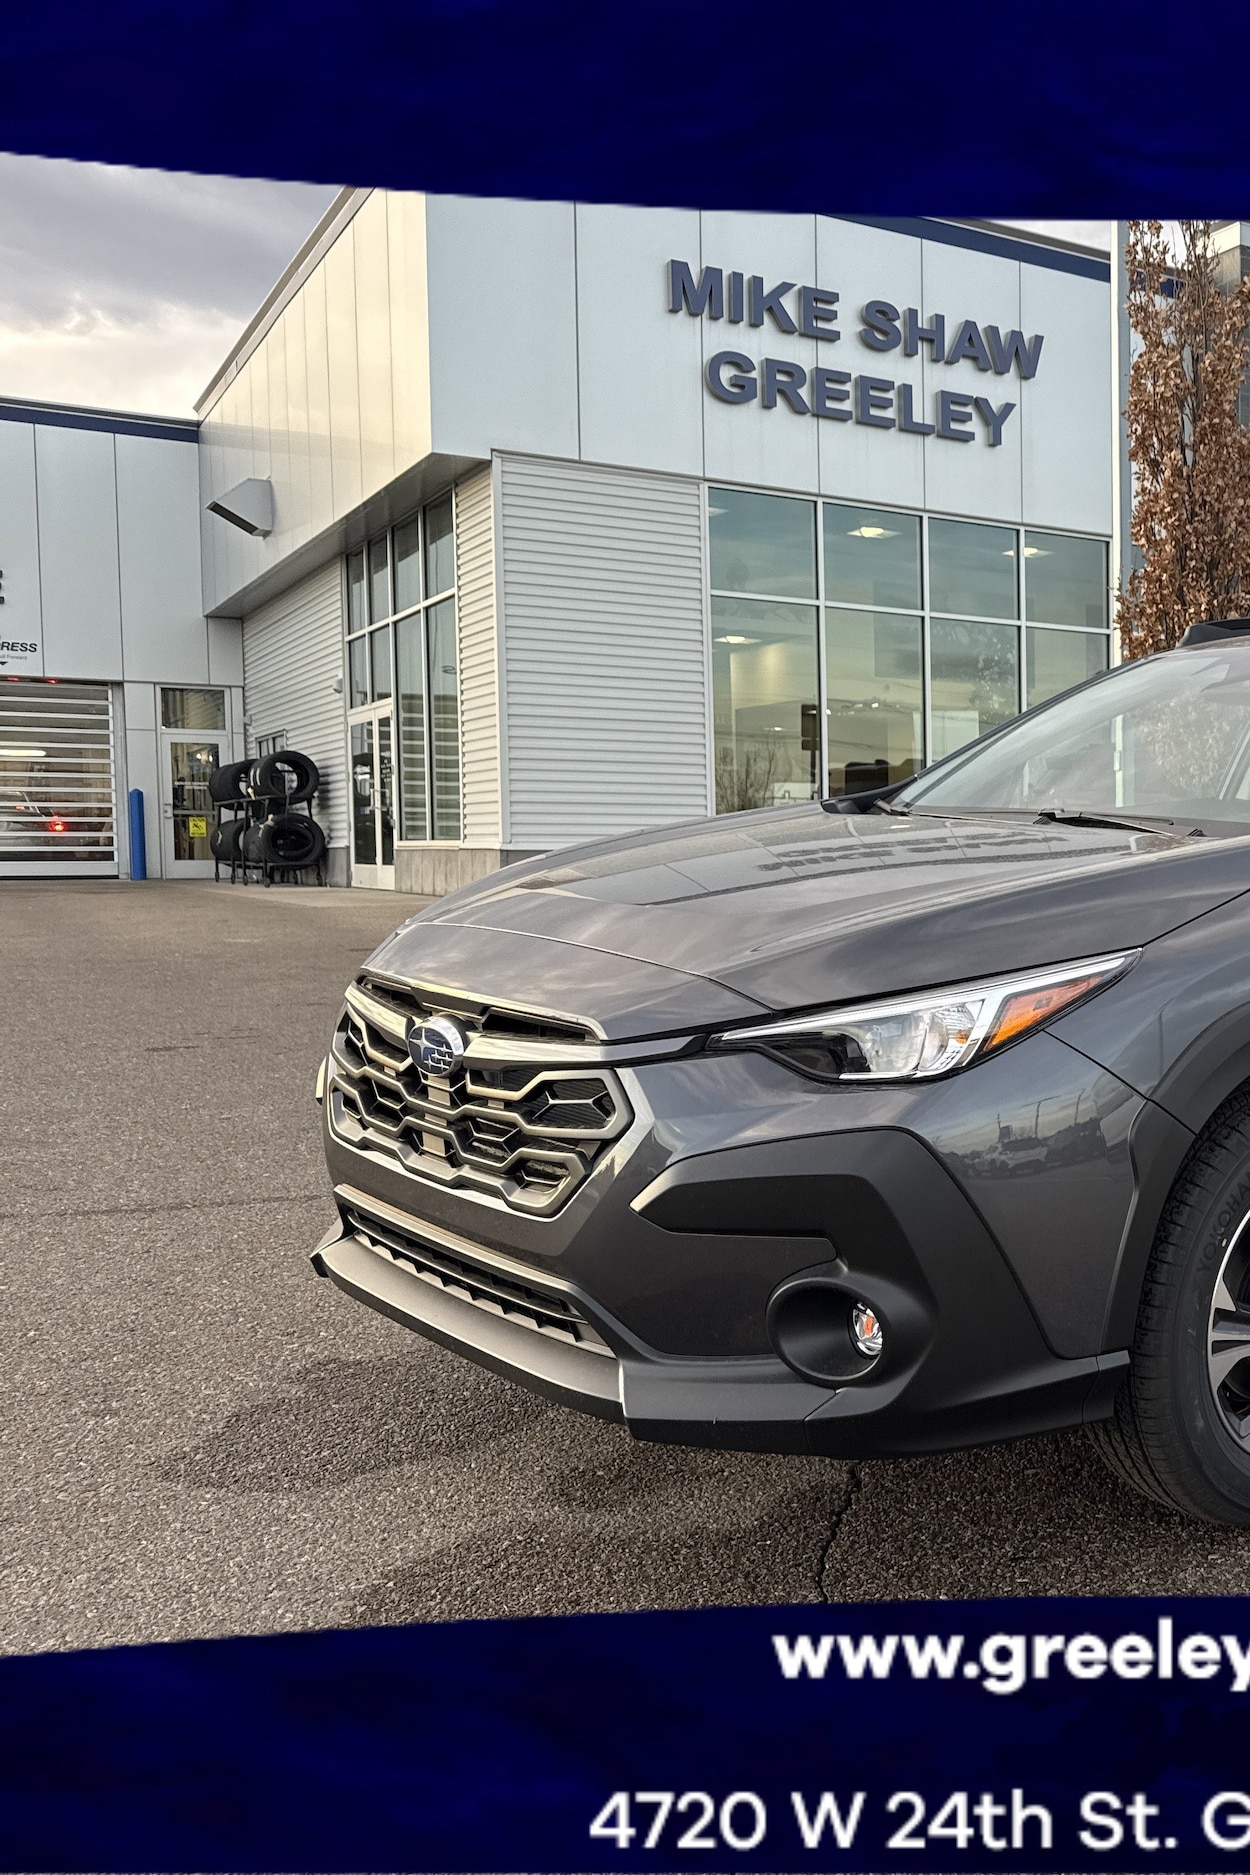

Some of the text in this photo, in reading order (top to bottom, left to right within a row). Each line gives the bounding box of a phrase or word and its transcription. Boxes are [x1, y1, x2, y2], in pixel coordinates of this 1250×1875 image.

[666, 258, 1044, 380] MIKE SHAW
[705, 350, 1017, 447] GREELEY
[0, 641, 38, 653] RESS
